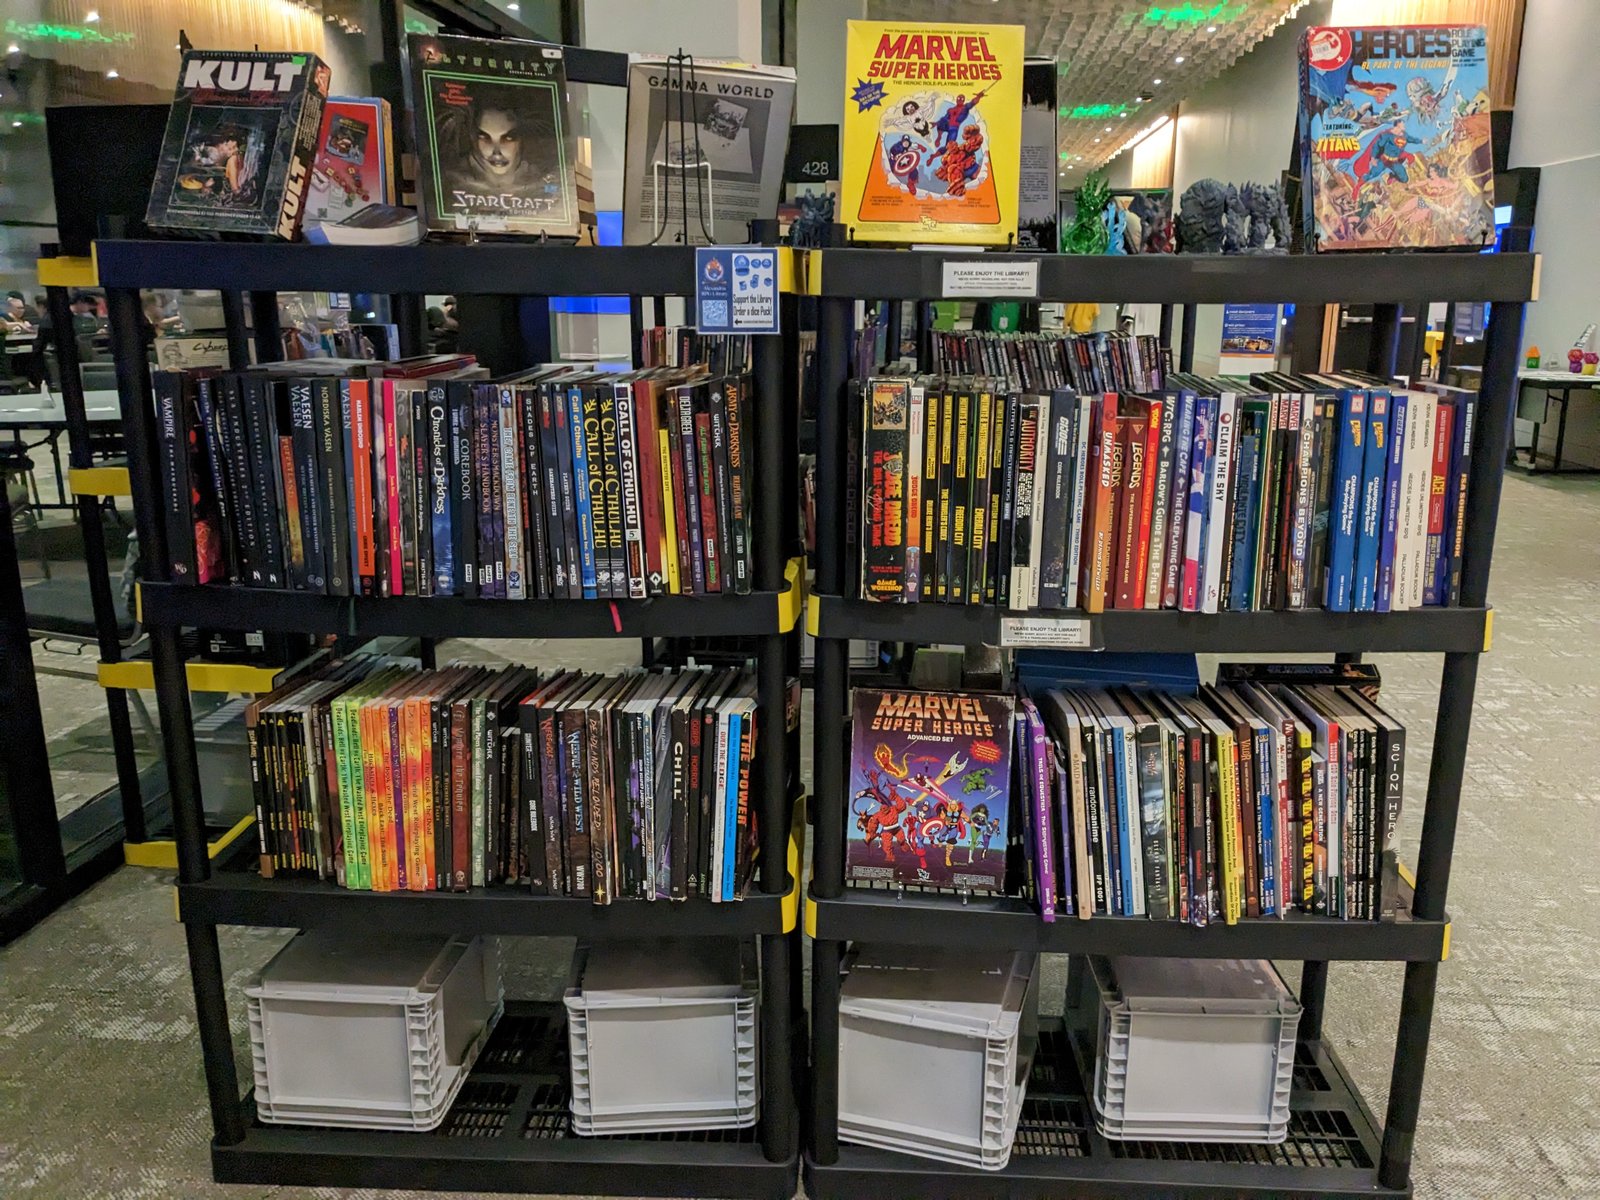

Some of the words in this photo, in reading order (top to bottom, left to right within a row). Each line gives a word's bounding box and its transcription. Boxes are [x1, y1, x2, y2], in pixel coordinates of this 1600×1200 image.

[874, 34, 996, 62] MARVEL
[1351, 29, 1450, 60] HEROES
[1452, 29, 1471, 38] ROLE
[1452, 38, 1486, 48] PLAYING
[1361, 62, 1370, 70] BE
[1394, 62, 1403, 70] OF
[1406, 62, 1417, 70] THE
[1452, 48, 1475, 57] GAME
[184, 60, 303, 92] KULT
[867, 61, 930, 79] SUPER
[933, 63, 1002, 81] HEROES
[648, 76, 708, 93] GAMMA
[717, 84, 774, 99] WORLD
[1316, 137, 1361, 152] TITANS
[802, 161, 829, 176] 428
[277, 155, 307, 241] KULT
[733, 294, 750, 304] Support
[757, 294, 772, 305] Library
[733, 306, 746, 316] Order
[291, 386, 302, 427] VAESEN
[321, 387, 329, 426] NORDISKA
[325, 428, 333, 452] VÄSEN
[342, 388, 352, 428] VAESEN
[574, 413, 580, 423] of
[618, 401, 630, 434] CALL
[1184, 395, 1194, 434] WEARING
[1280, 400, 1289, 428] MARVEL
[1290, 400, 1300, 429] MARVEL
[430, 406, 446, 456] Chronicles
[492, 420, 500, 456] MONSTER
[504, 428, 512, 444] THEY
[574, 426, 582, 458] Cthulhu
[585, 418, 600, 461] CALL
[602, 418, 617, 461] CALL
[622, 437, 631, 456] OF
[1020, 420, 1036, 471] AUTHORITY
[1219, 426, 1230, 458] CLAIM
[162, 397, 176, 438] VAMPIRE
[170, 461, 178, 512] MASQUERADE
[504, 448, 514, 468] CAME
[530, 445, 536, 458] OF
[1102, 431, 1113, 488] UNMASKED
[1110, 442, 1122, 487] LEGENDS
[1128, 442, 1142, 488] LEGENDS
[1179, 452, 1190, 474] CAPE
[233, 416, 246, 478] INDUSTRIES
[245, 504, 256, 546] EDITION
[282, 438, 294, 498] PUPPETLAND
[460, 439, 472, 500] COREBOOK
[506, 470, 514, 490] FROM
[530, 464, 538, 496] EARTH
[588, 464, 600, 474] of
[606, 464, 616, 474] of
[1217, 462, 1228, 478] THE
[1300, 432, 1311, 504] CHAMPIONS
[433, 468, 447, 514] Darkness
[492, 459, 501, 511] SMACKDOWN
[624, 460, 638, 524] CTHULHU
[1176, 492, 1185, 507] THE
[1216, 482, 1227, 502] SKY
[1364, 482, 1373, 514] Role-playing
[1371, 476, 1379, 510] CHAMPIONS
[1432, 475, 1446, 495] ACE!
[507, 493, 516, 524] BENEATH
[589, 479, 606, 548] CTHULHU
[606, 479, 622, 548] CTHULHU
[955, 506, 964, 530] FREEDOM
[974, 508, 984, 532] EMERALD
[508, 527, 517, 540] THE
[954, 532, 964, 545] CITY
[973, 536, 983, 549] CITY
[1170, 509, 1183, 563] ROLEPLAYING
[1296, 508, 1306, 556] BEYOND
[1168, 564, 1178, 588] GAME
[876, 693, 990, 722] MARVEL
[691, 720, 699, 745] GURPS
[871, 718, 924, 731] SUPER
[933, 721, 994, 737] HEROES
[907, 734, 941, 742] ADVANCED
[741, 734, 750, 760] THE
[1240, 738, 1251, 760] VALOR
[674, 742, 683, 799] CHILL
[1390, 744, 1401, 792] SCION
[738, 769, 749, 824] POWER
[1089, 786, 1100, 842] randomanime
[1388, 803, 1398, 840] HERO
